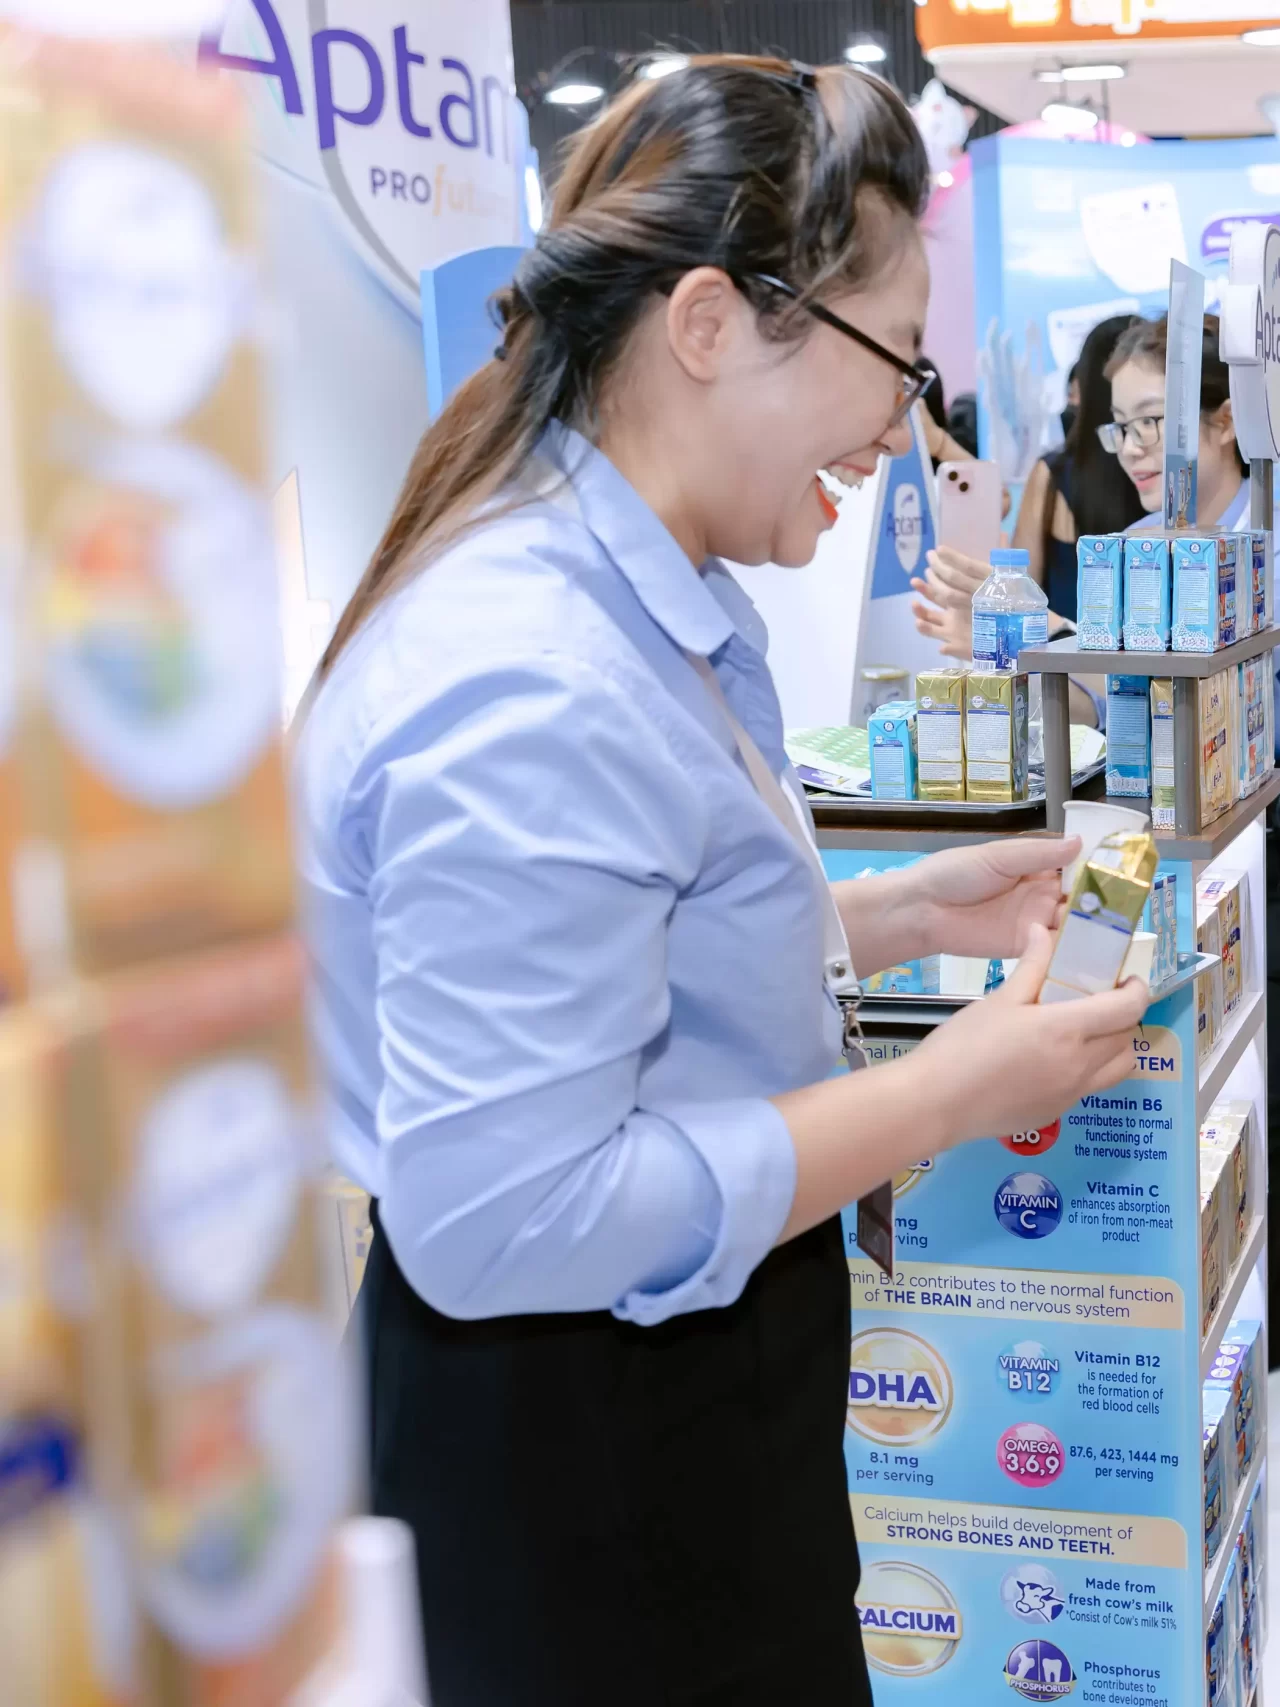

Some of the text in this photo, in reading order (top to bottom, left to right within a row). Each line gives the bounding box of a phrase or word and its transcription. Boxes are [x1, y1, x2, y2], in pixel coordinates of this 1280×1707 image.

[1133, 1038, 1150, 1052] to
[1081, 1096, 1163, 1111] Vitamin B6
[1068, 1114, 1173, 1129] contributes to normal
[1085, 1129, 1153, 1146] functioning of
[1075, 1144, 1168, 1161] the nervous system
[1087, 1182, 1159, 1197] Vitamin C
[998, 1194, 1058, 1209] VITAMIN
[1071, 1198, 1170, 1215] enhances absorption
[1020, 1210, 1037, 1229] C
[1068, 1213, 1173, 1229] of iron from non-meat
[1102, 1231, 1140, 1242] product
[880, 1273, 905, 1287] B2
[909, 1274, 996, 1293] contributes
[1000, 1280, 1016, 1293] to
[1021, 1280, 1046, 1296] the
[1050, 1284, 1104, 1299] normal
[1109, 1285, 1174, 1303] function
[864, 1289, 1130, 1318] of THE BRAIN and nervous system
[999, 1356, 1059, 1372] VITAMIN
[1075, 1351, 1161, 1368] Vitamin B12
[1008, 1371, 1051, 1392] B12
[1088, 1369, 1156, 1384] is needed for
[849, 1371, 937, 1404] DHA
[1078, 1383, 1164, 1400] the formation of
[1082, 1400, 1160, 1414] red blood cells
[1004, 1439, 1060, 1455] OMEGA
[870, 1452, 919, 1468] 8.1 mg
[1006, 1452, 1060, 1475] 3,6,9
[1070, 1446, 1179, 1467] 87.6, 423, 1444 mg
[856, 1469, 934, 1486] per serving
[1095, 1466, 1154, 1482] per serving
[864, 1506, 1133, 1540] Calcium helps build development of
[887, 1525, 1115, 1555] STRONG BONES AND TEETH.
[1085, 1577, 1156, 1594] Made from
[1068, 1593, 1173, 1613] fresh cow's milk
[1102, 1612, 1111, 1624] of
[1114, 1614, 1139, 1627] Cow's
[1141, 1615, 1159, 1628] milk
[1161, 1618, 1177, 1630] 51%
[1084, 1662, 1161, 1679] Phosphorus
[1010, 1679, 1070, 1693] PHOSPHORUS
[1092, 1679, 1156, 1694] contributes to
[1083, 1691, 1168, 1707] bone development
